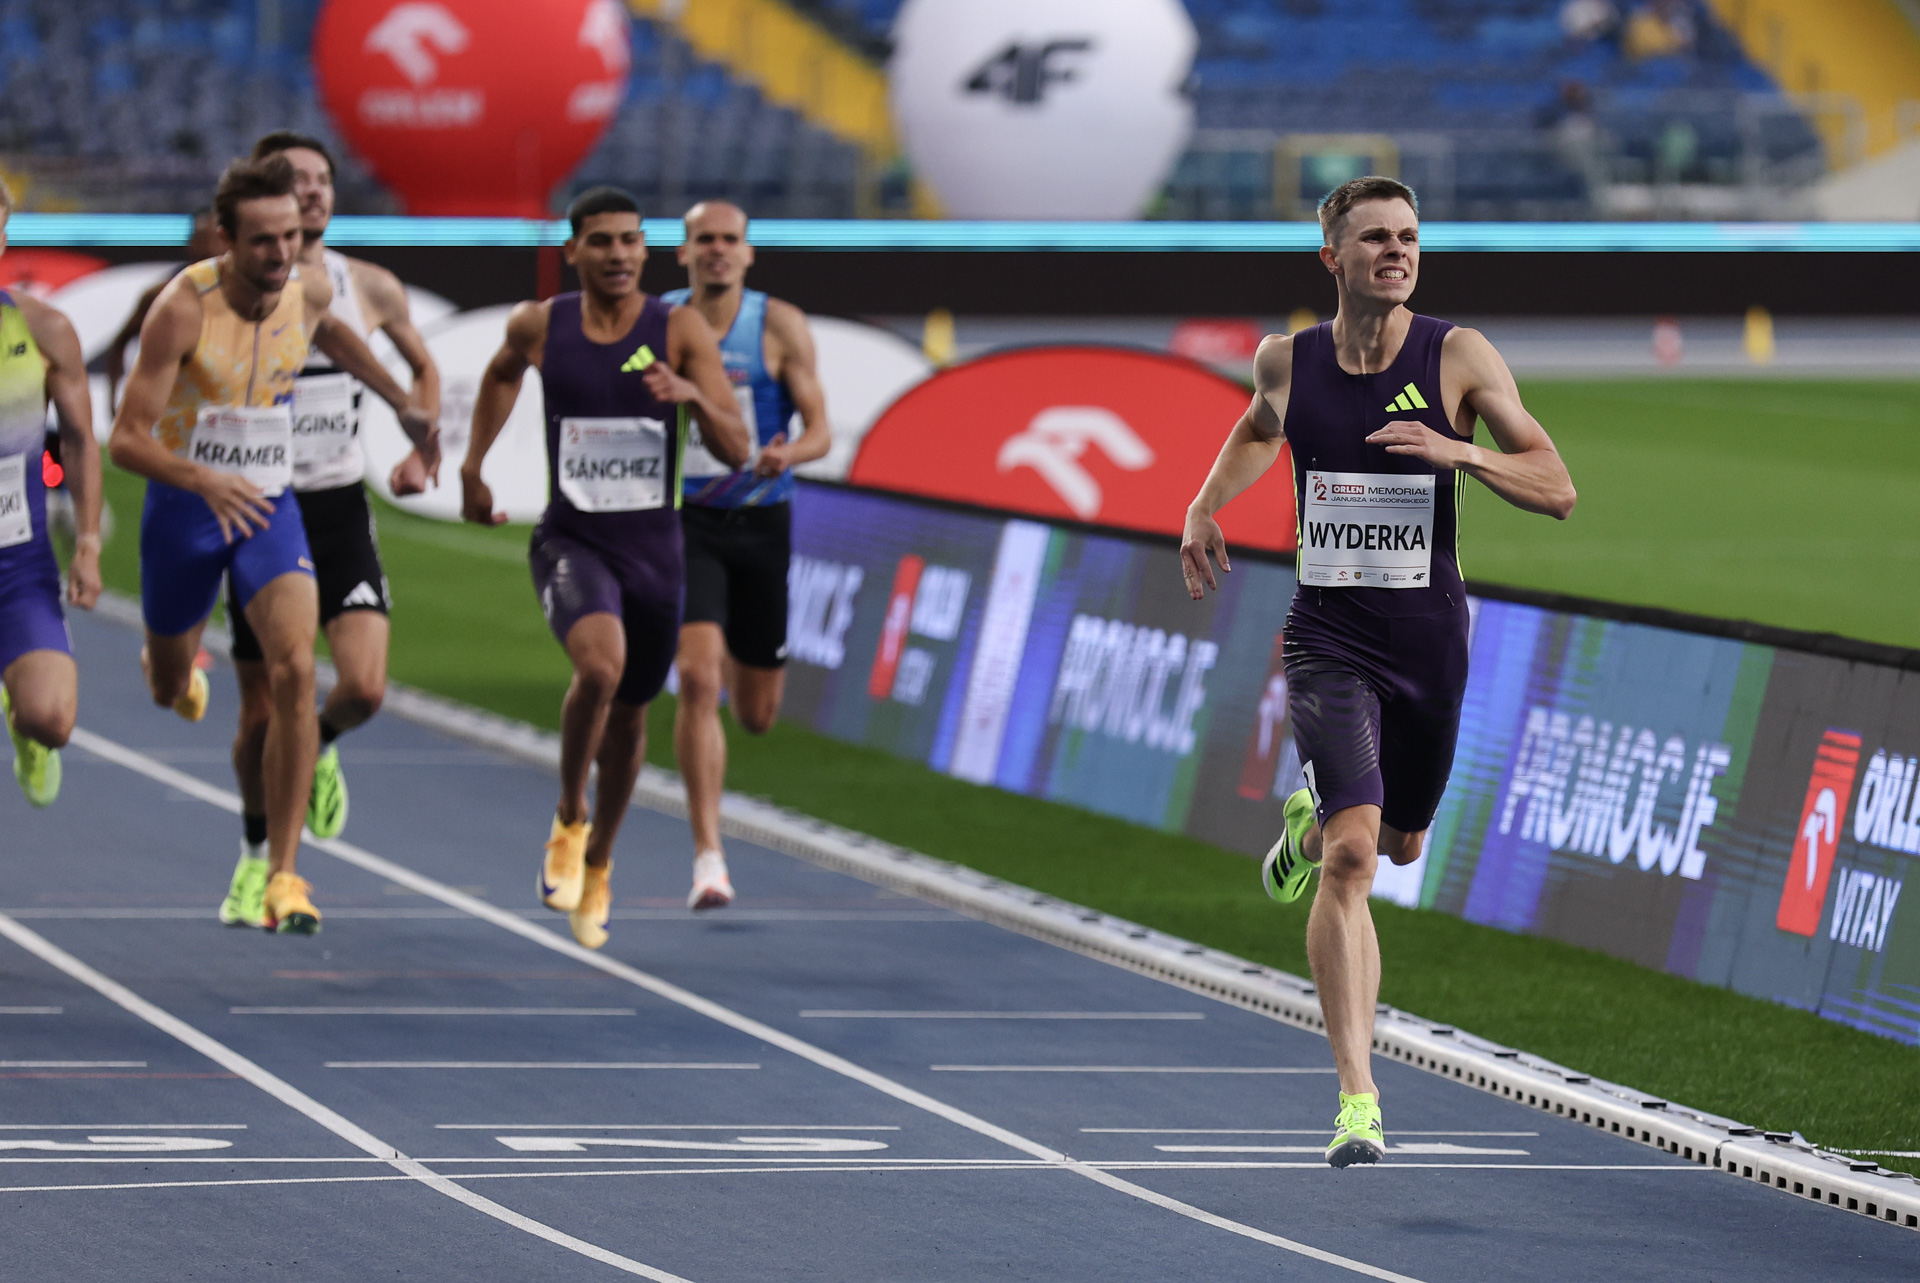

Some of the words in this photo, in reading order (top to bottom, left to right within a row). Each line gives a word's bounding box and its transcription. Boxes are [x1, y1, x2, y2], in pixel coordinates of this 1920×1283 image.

[193, 440, 286, 468] KRAMER
[564, 452, 660, 480] SÁNCHEZ
[1333, 485, 1364, 494] ORLEN
[1368, 486, 1429, 496] MEMORIAŁ
[1308, 521, 1426, 551] WYDERKA
[1499, 705, 1732, 881] PROMOCJE
[1853, 747, 1920, 856] ORLE
[1829, 865, 1902, 953] VITAY
